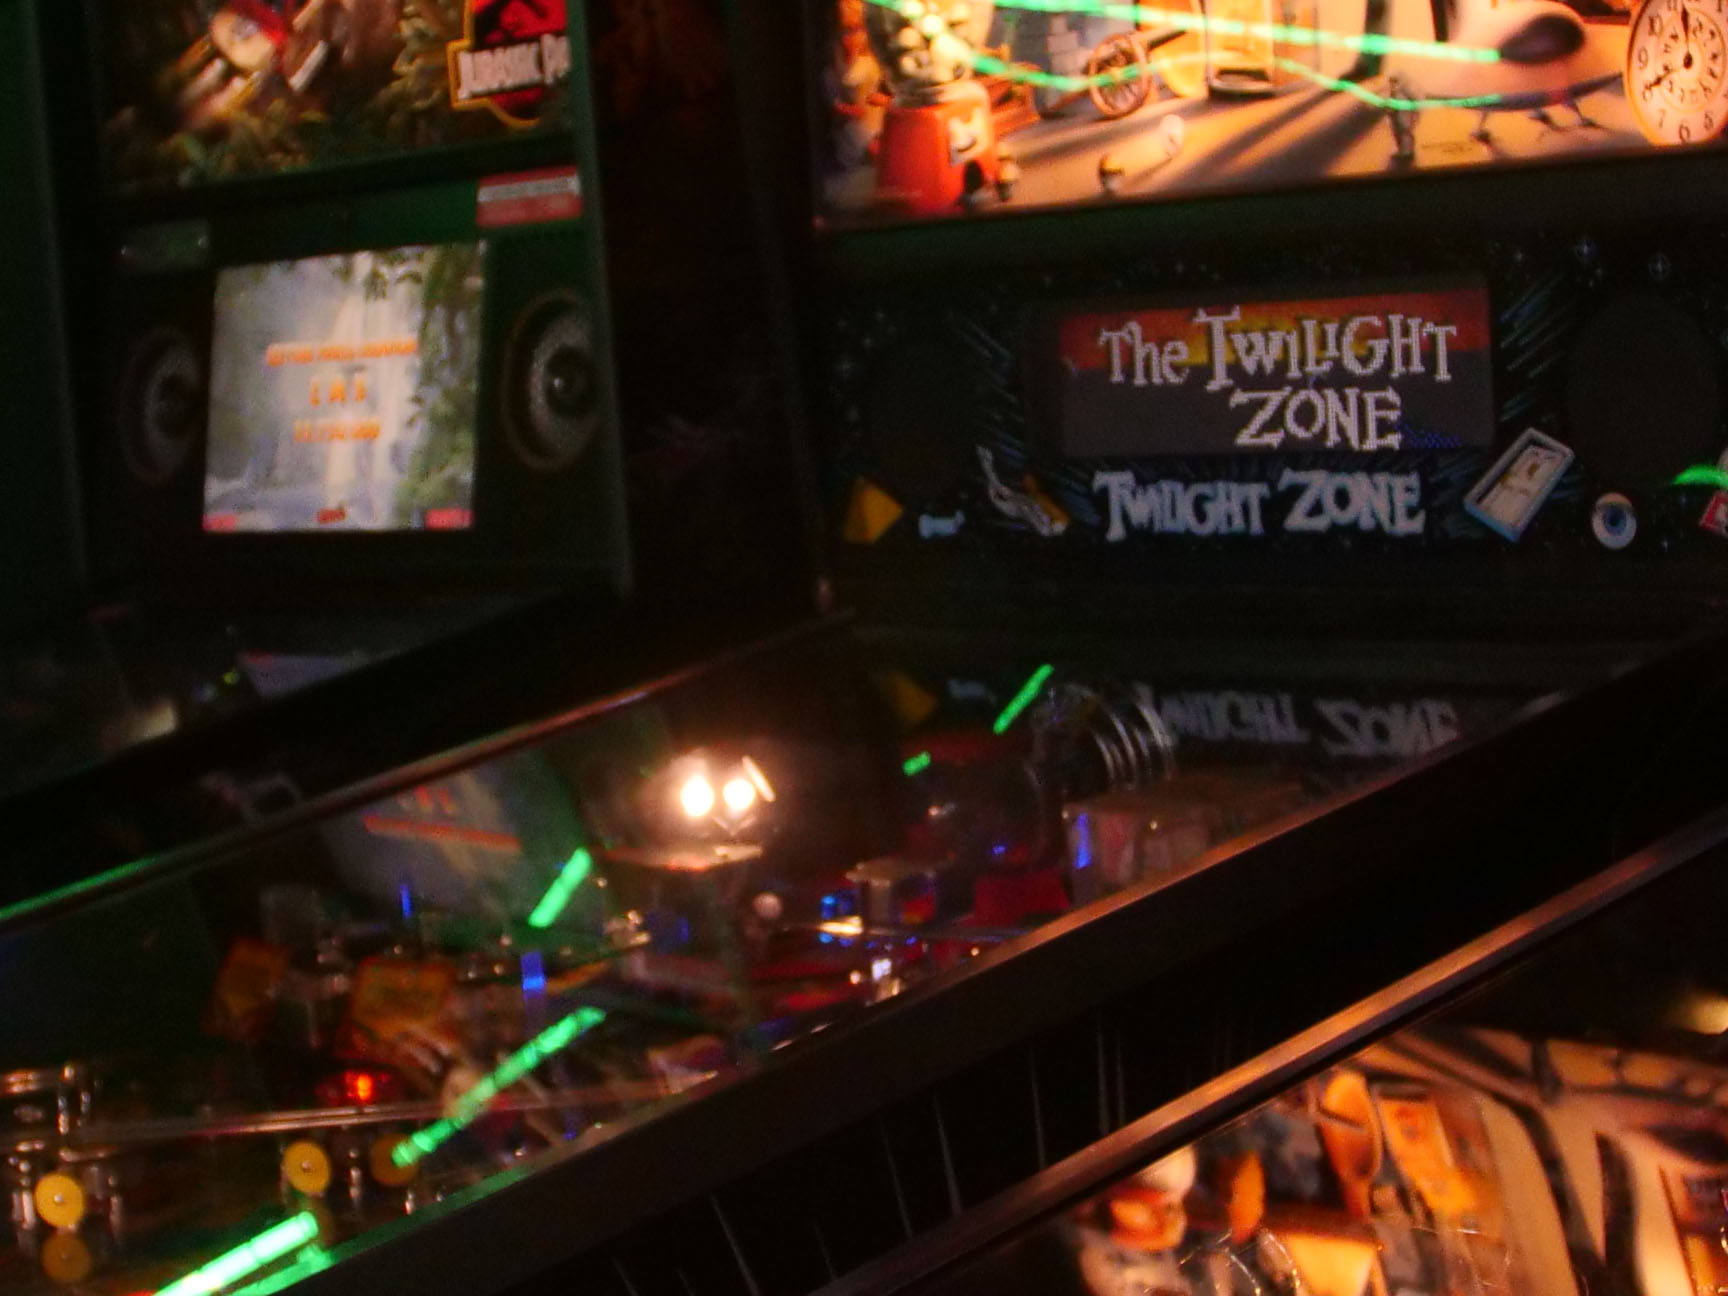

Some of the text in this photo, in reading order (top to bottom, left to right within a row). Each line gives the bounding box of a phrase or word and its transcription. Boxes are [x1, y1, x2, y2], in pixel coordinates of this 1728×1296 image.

[1097, 321, 1191, 387] The
[1228, 386, 1404, 452] ZONE
[1092, 468, 1426, 543] TWILIGHT ZONE
